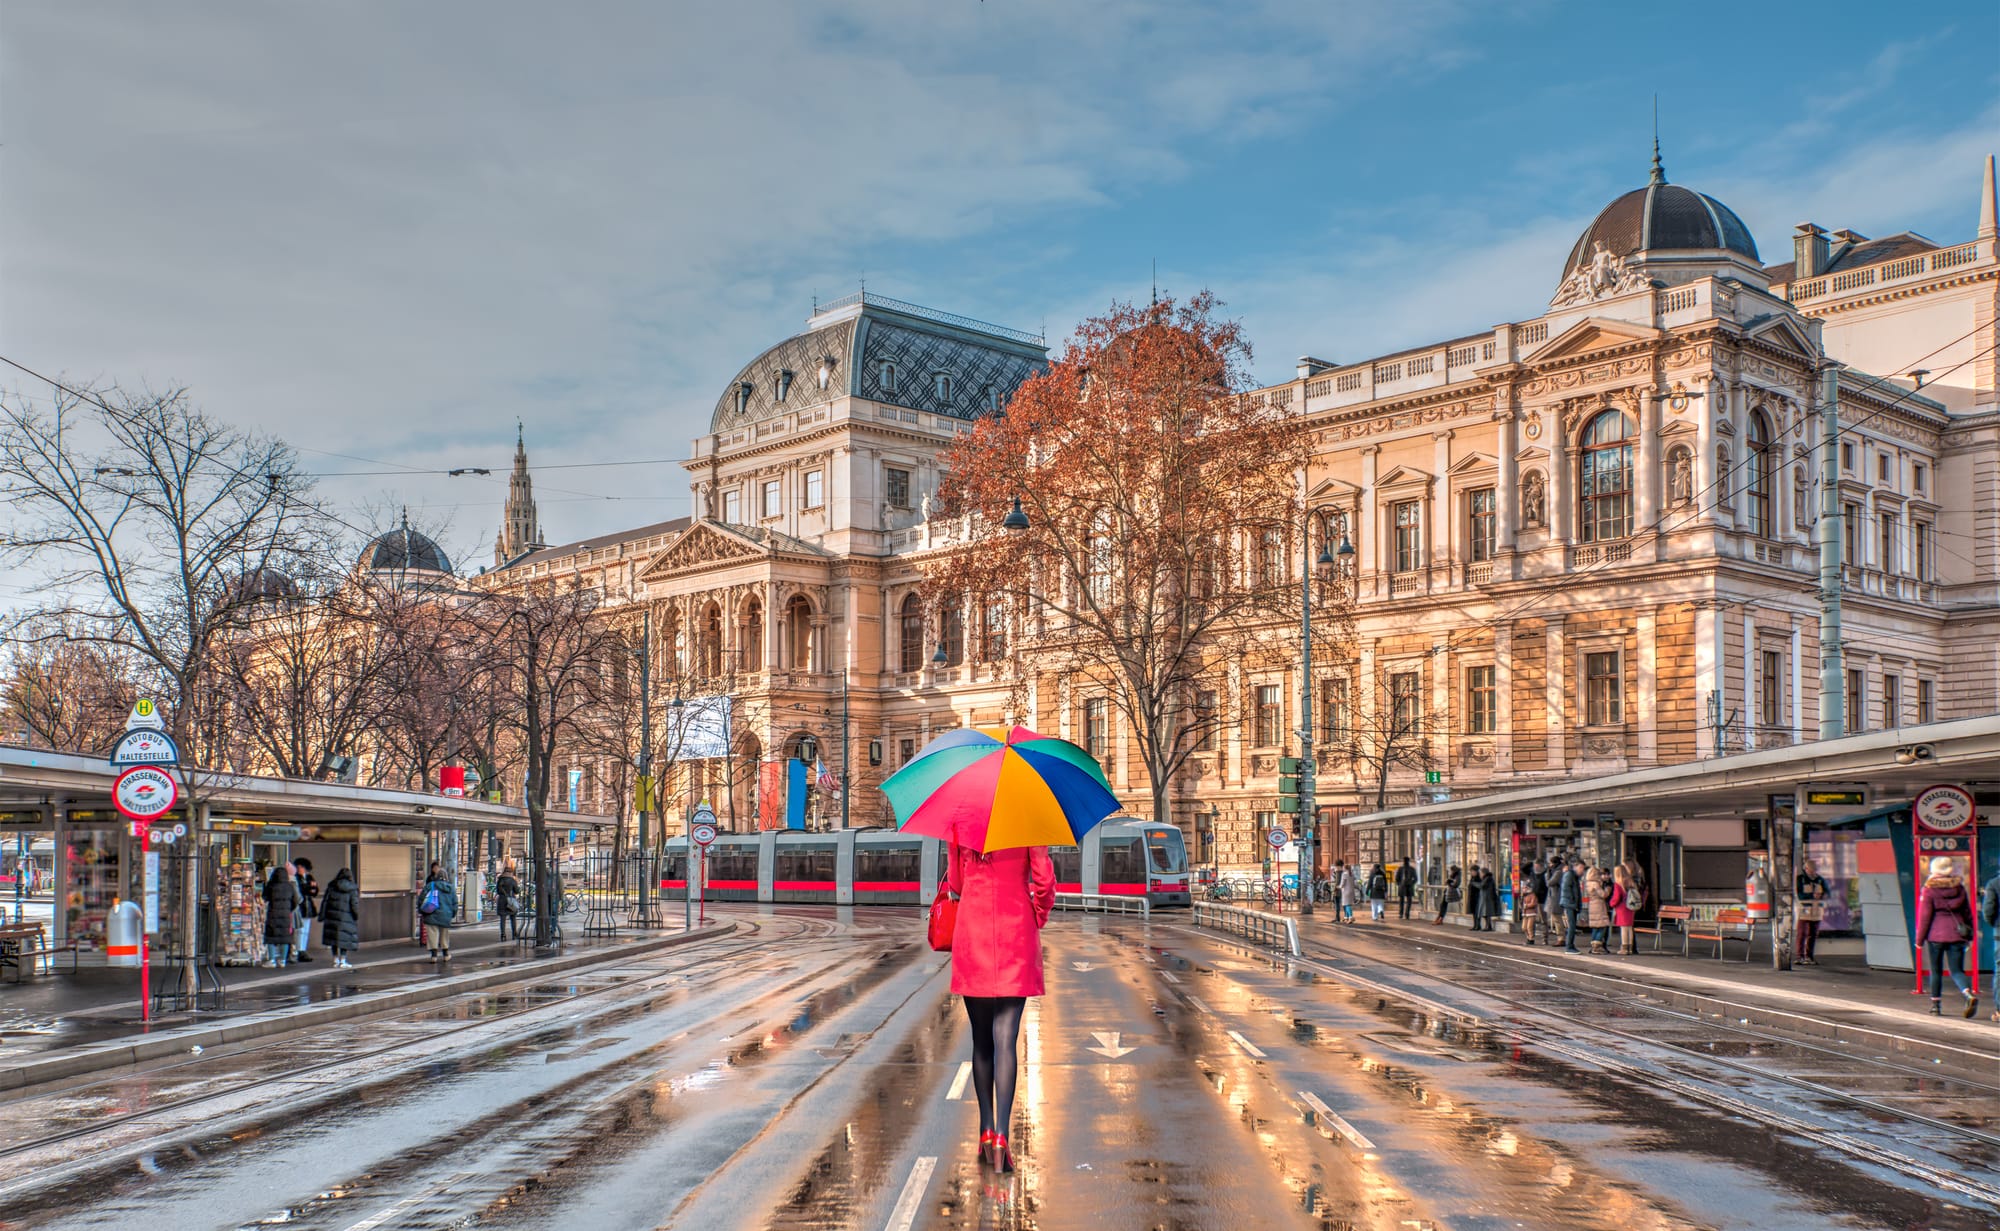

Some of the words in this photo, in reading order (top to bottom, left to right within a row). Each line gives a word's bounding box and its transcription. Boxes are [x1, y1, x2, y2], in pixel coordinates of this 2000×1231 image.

[139, 702, 149, 713] H
[127, 733, 164, 746] AUTOBUS
[120, 752, 170, 761] HALTESTELLE
[120, 772, 170, 790] STRASSENBAHN
[1922, 790, 1967, 806] STRASSENBAHN
[123, 797, 167, 813] HALTESTELLE
[1923, 814, 1966, 828] HALTESTELLE
[176, 826, 183, 834] D
